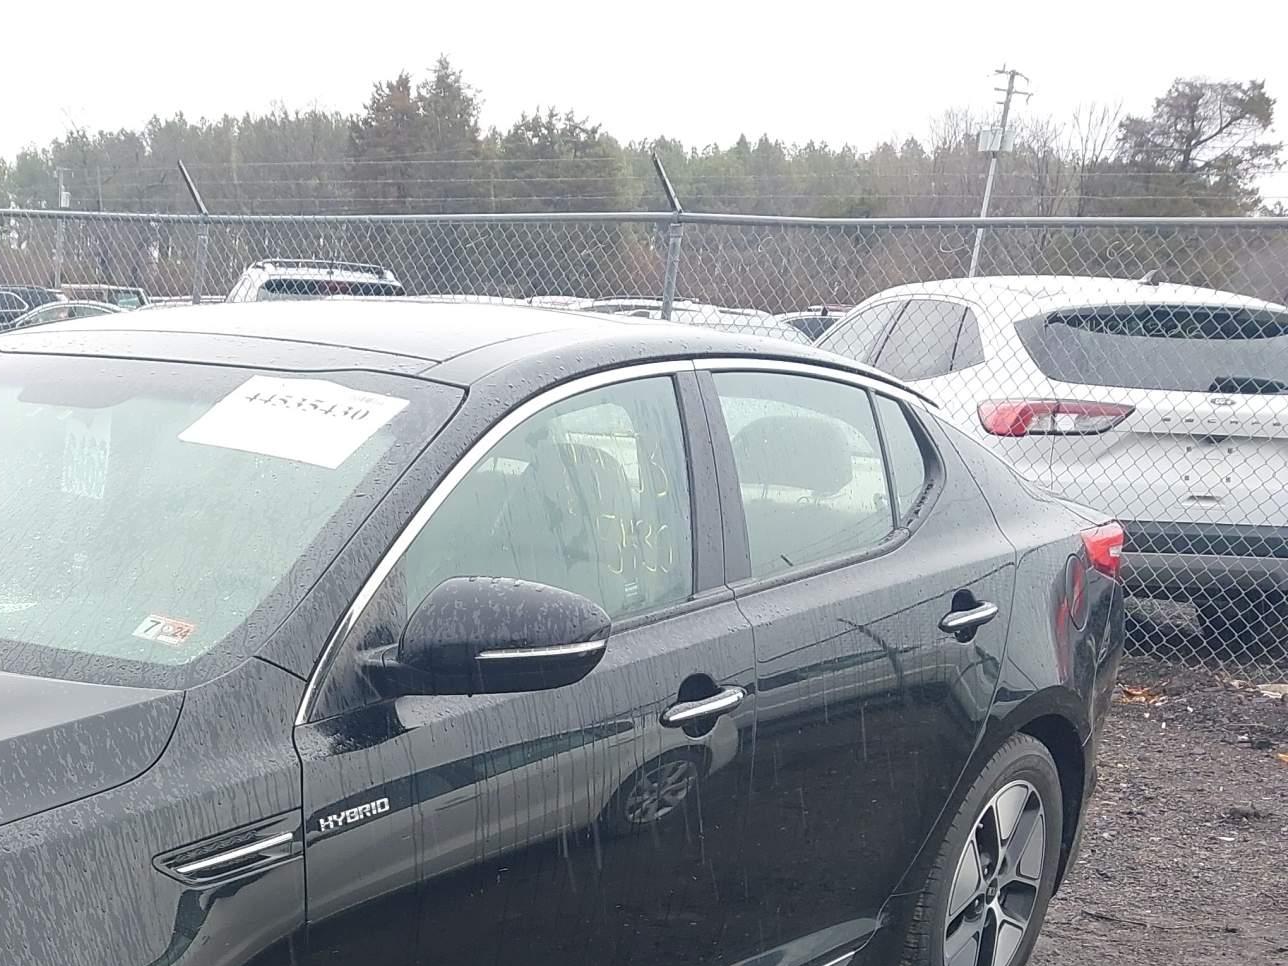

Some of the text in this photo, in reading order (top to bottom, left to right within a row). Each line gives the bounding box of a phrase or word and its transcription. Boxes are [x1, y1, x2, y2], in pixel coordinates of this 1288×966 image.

[245, 392, 370, 421] 44535430
[143, 619, 162, 634] 7
[319, 797, 390, 832] HYBRID
